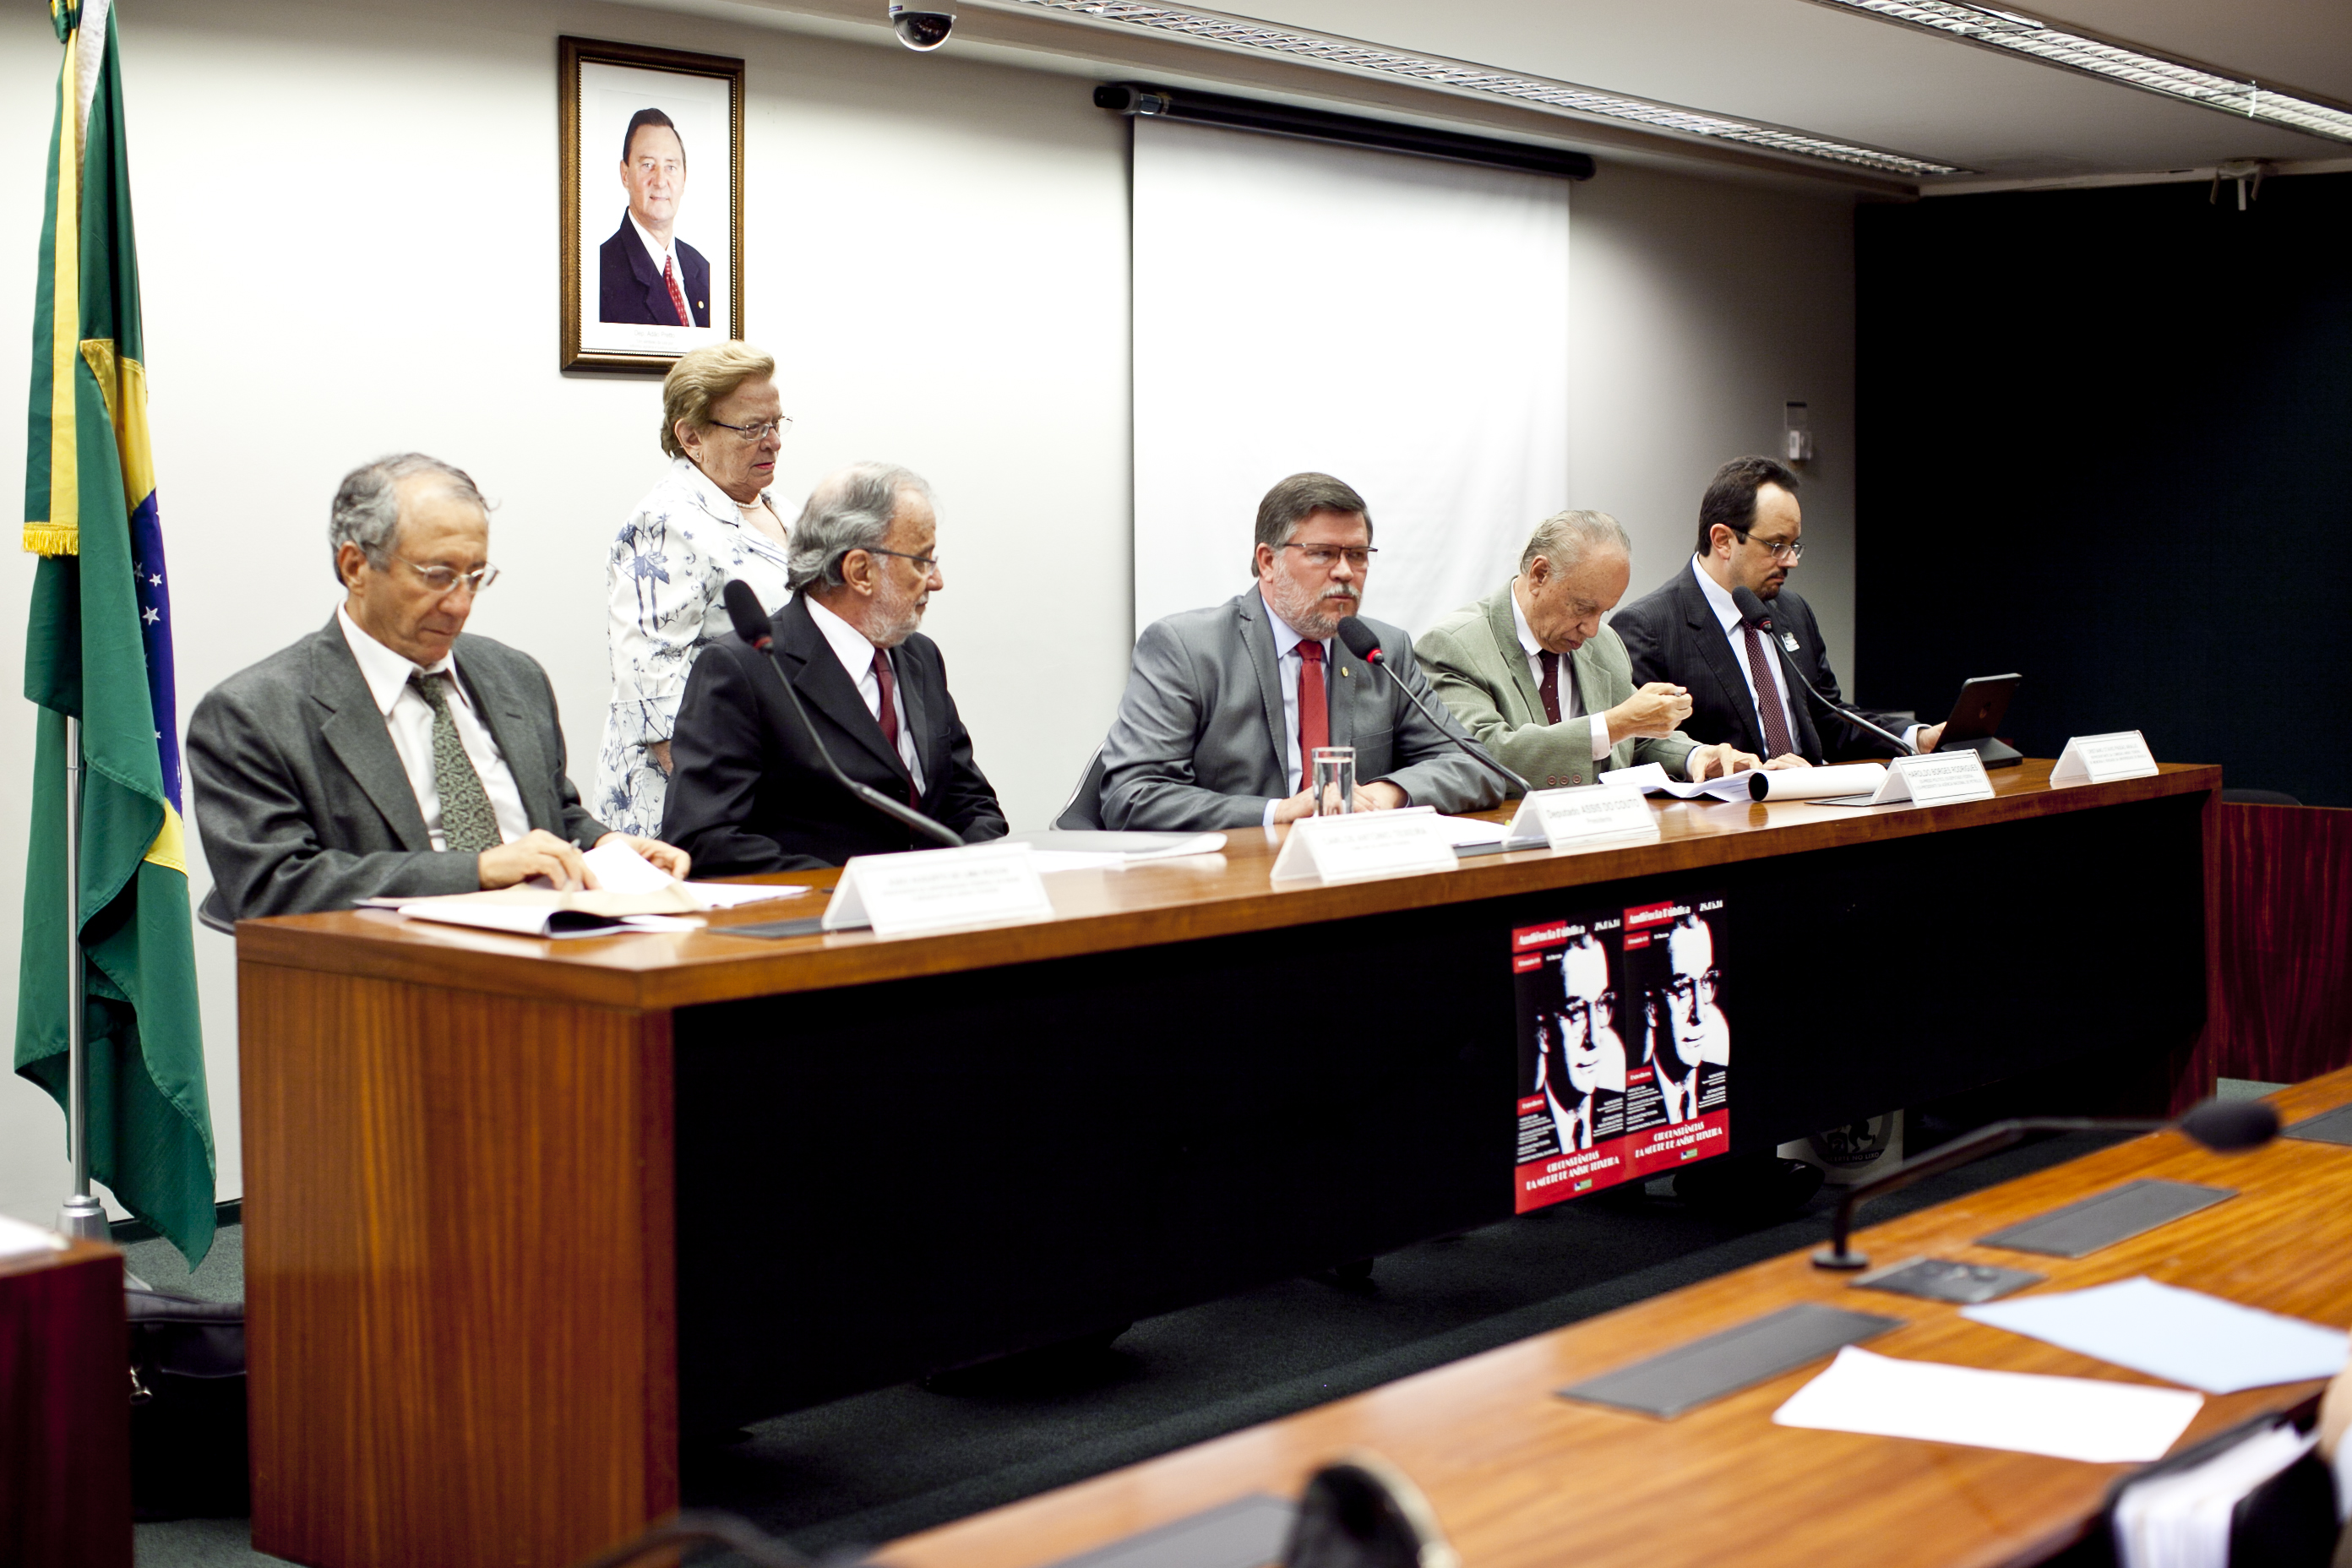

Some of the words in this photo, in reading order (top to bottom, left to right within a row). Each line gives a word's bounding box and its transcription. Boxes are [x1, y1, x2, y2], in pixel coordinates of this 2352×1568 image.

[1908, 769, 1931, 777] HAROLDO
[1931, 767, 1952, 776] BORGES
[1952, 765, 1979, 773] RODRIGUES
[1546, 808, 1580, 819] Deputado
[1582, 803, 1602, 813] ASSIS
[1602, 802, 1614, 811] DO
[1614, 798, 1640, 809] COUTO
[1653, 1121, 1705, 1142] CIRCUNSTÂNCIAS
[1696, 1127, 1723, 1141] TEIXEIRA
[1547, 1151, 1599, 1173] CIRCUNSTÂNCIAS
[1590, 1156, 1620, 1171] TEIXEIRA
